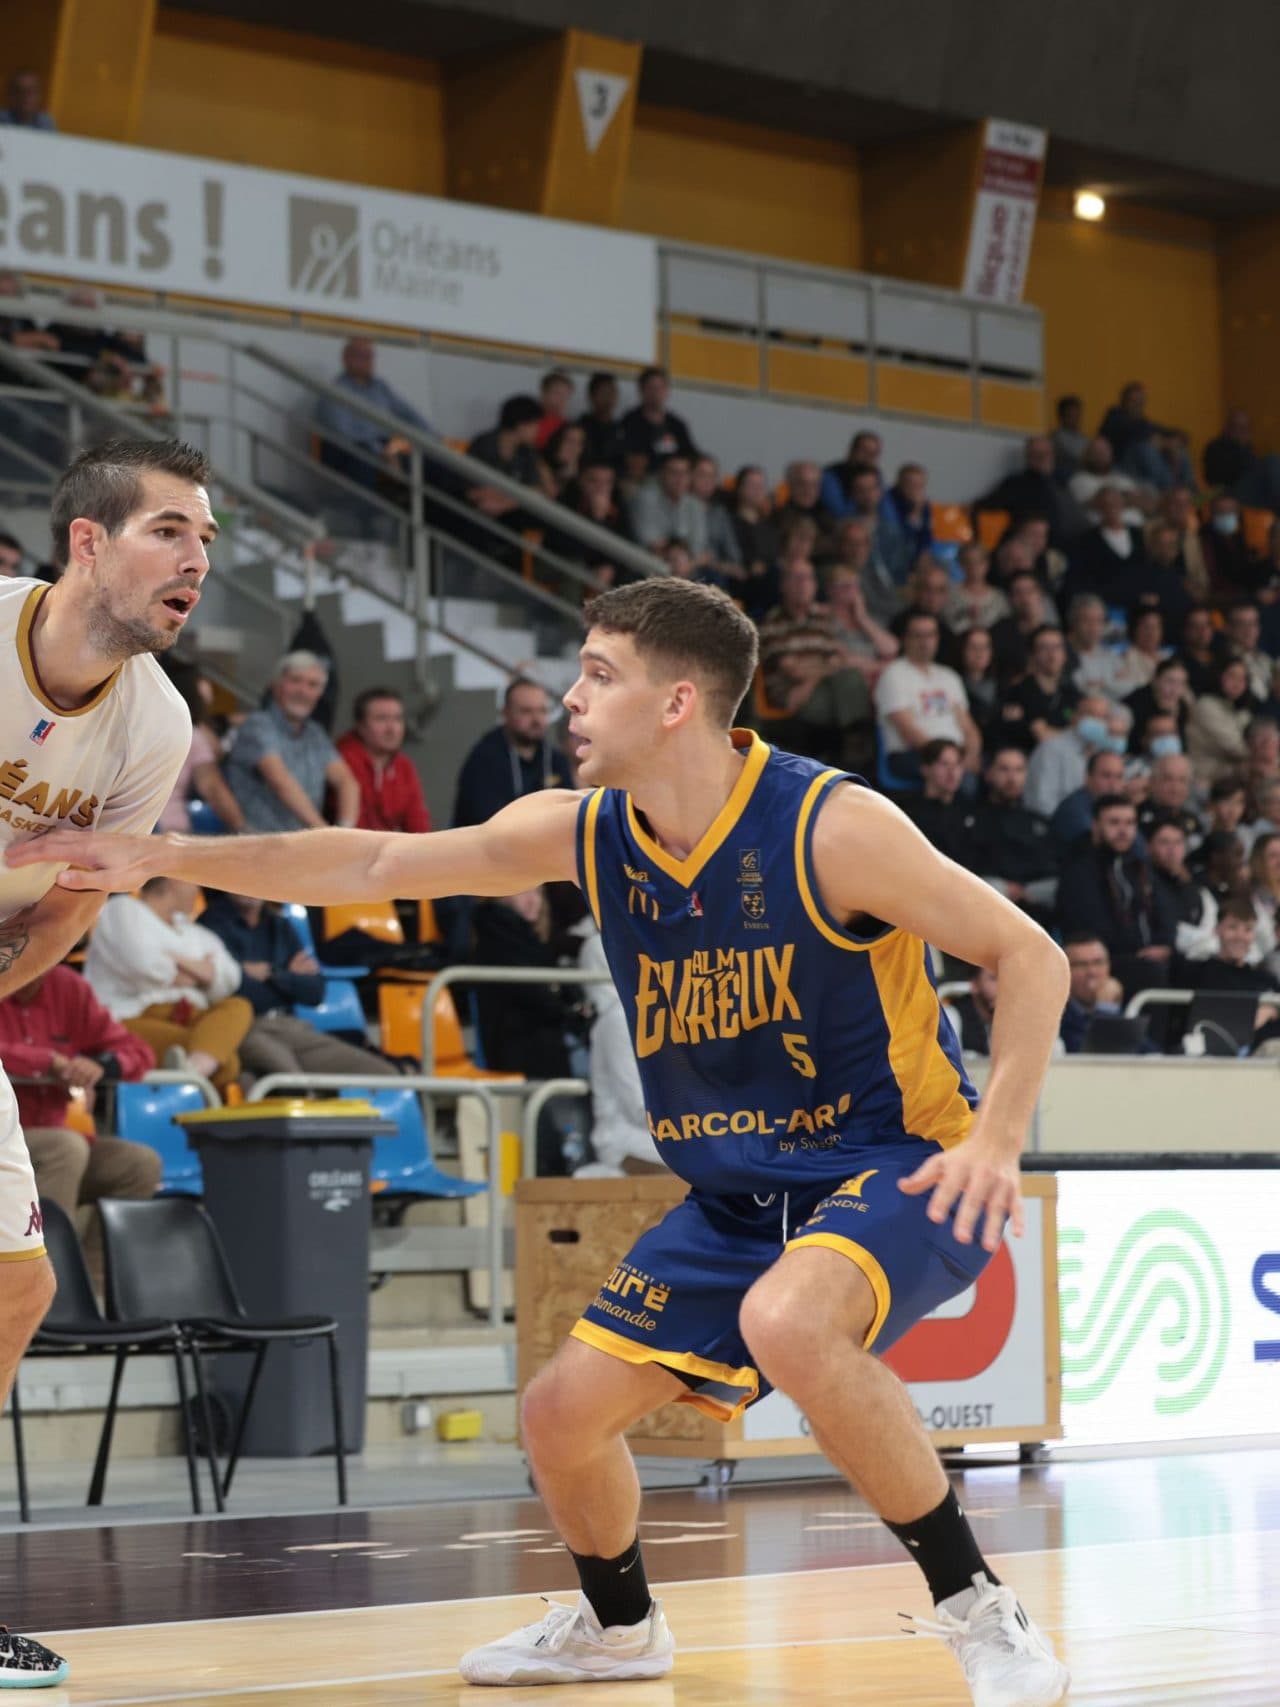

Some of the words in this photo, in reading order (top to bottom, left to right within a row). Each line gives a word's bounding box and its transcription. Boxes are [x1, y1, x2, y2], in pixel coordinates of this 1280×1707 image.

[591, 82, 609, 118] 3
[201, 179, 226, 281] !
[371, 219, 502, 278] Orléans
[374, 261, 464, 304] Mairie
[692, 947, 735, 976] ALM
[634, 943, 803, 1058] EVREUX
[782, 1032, 817, 1079] 5
[779, 1139, 796, 1155] by
[603, 1266, 670, 1313] ure
